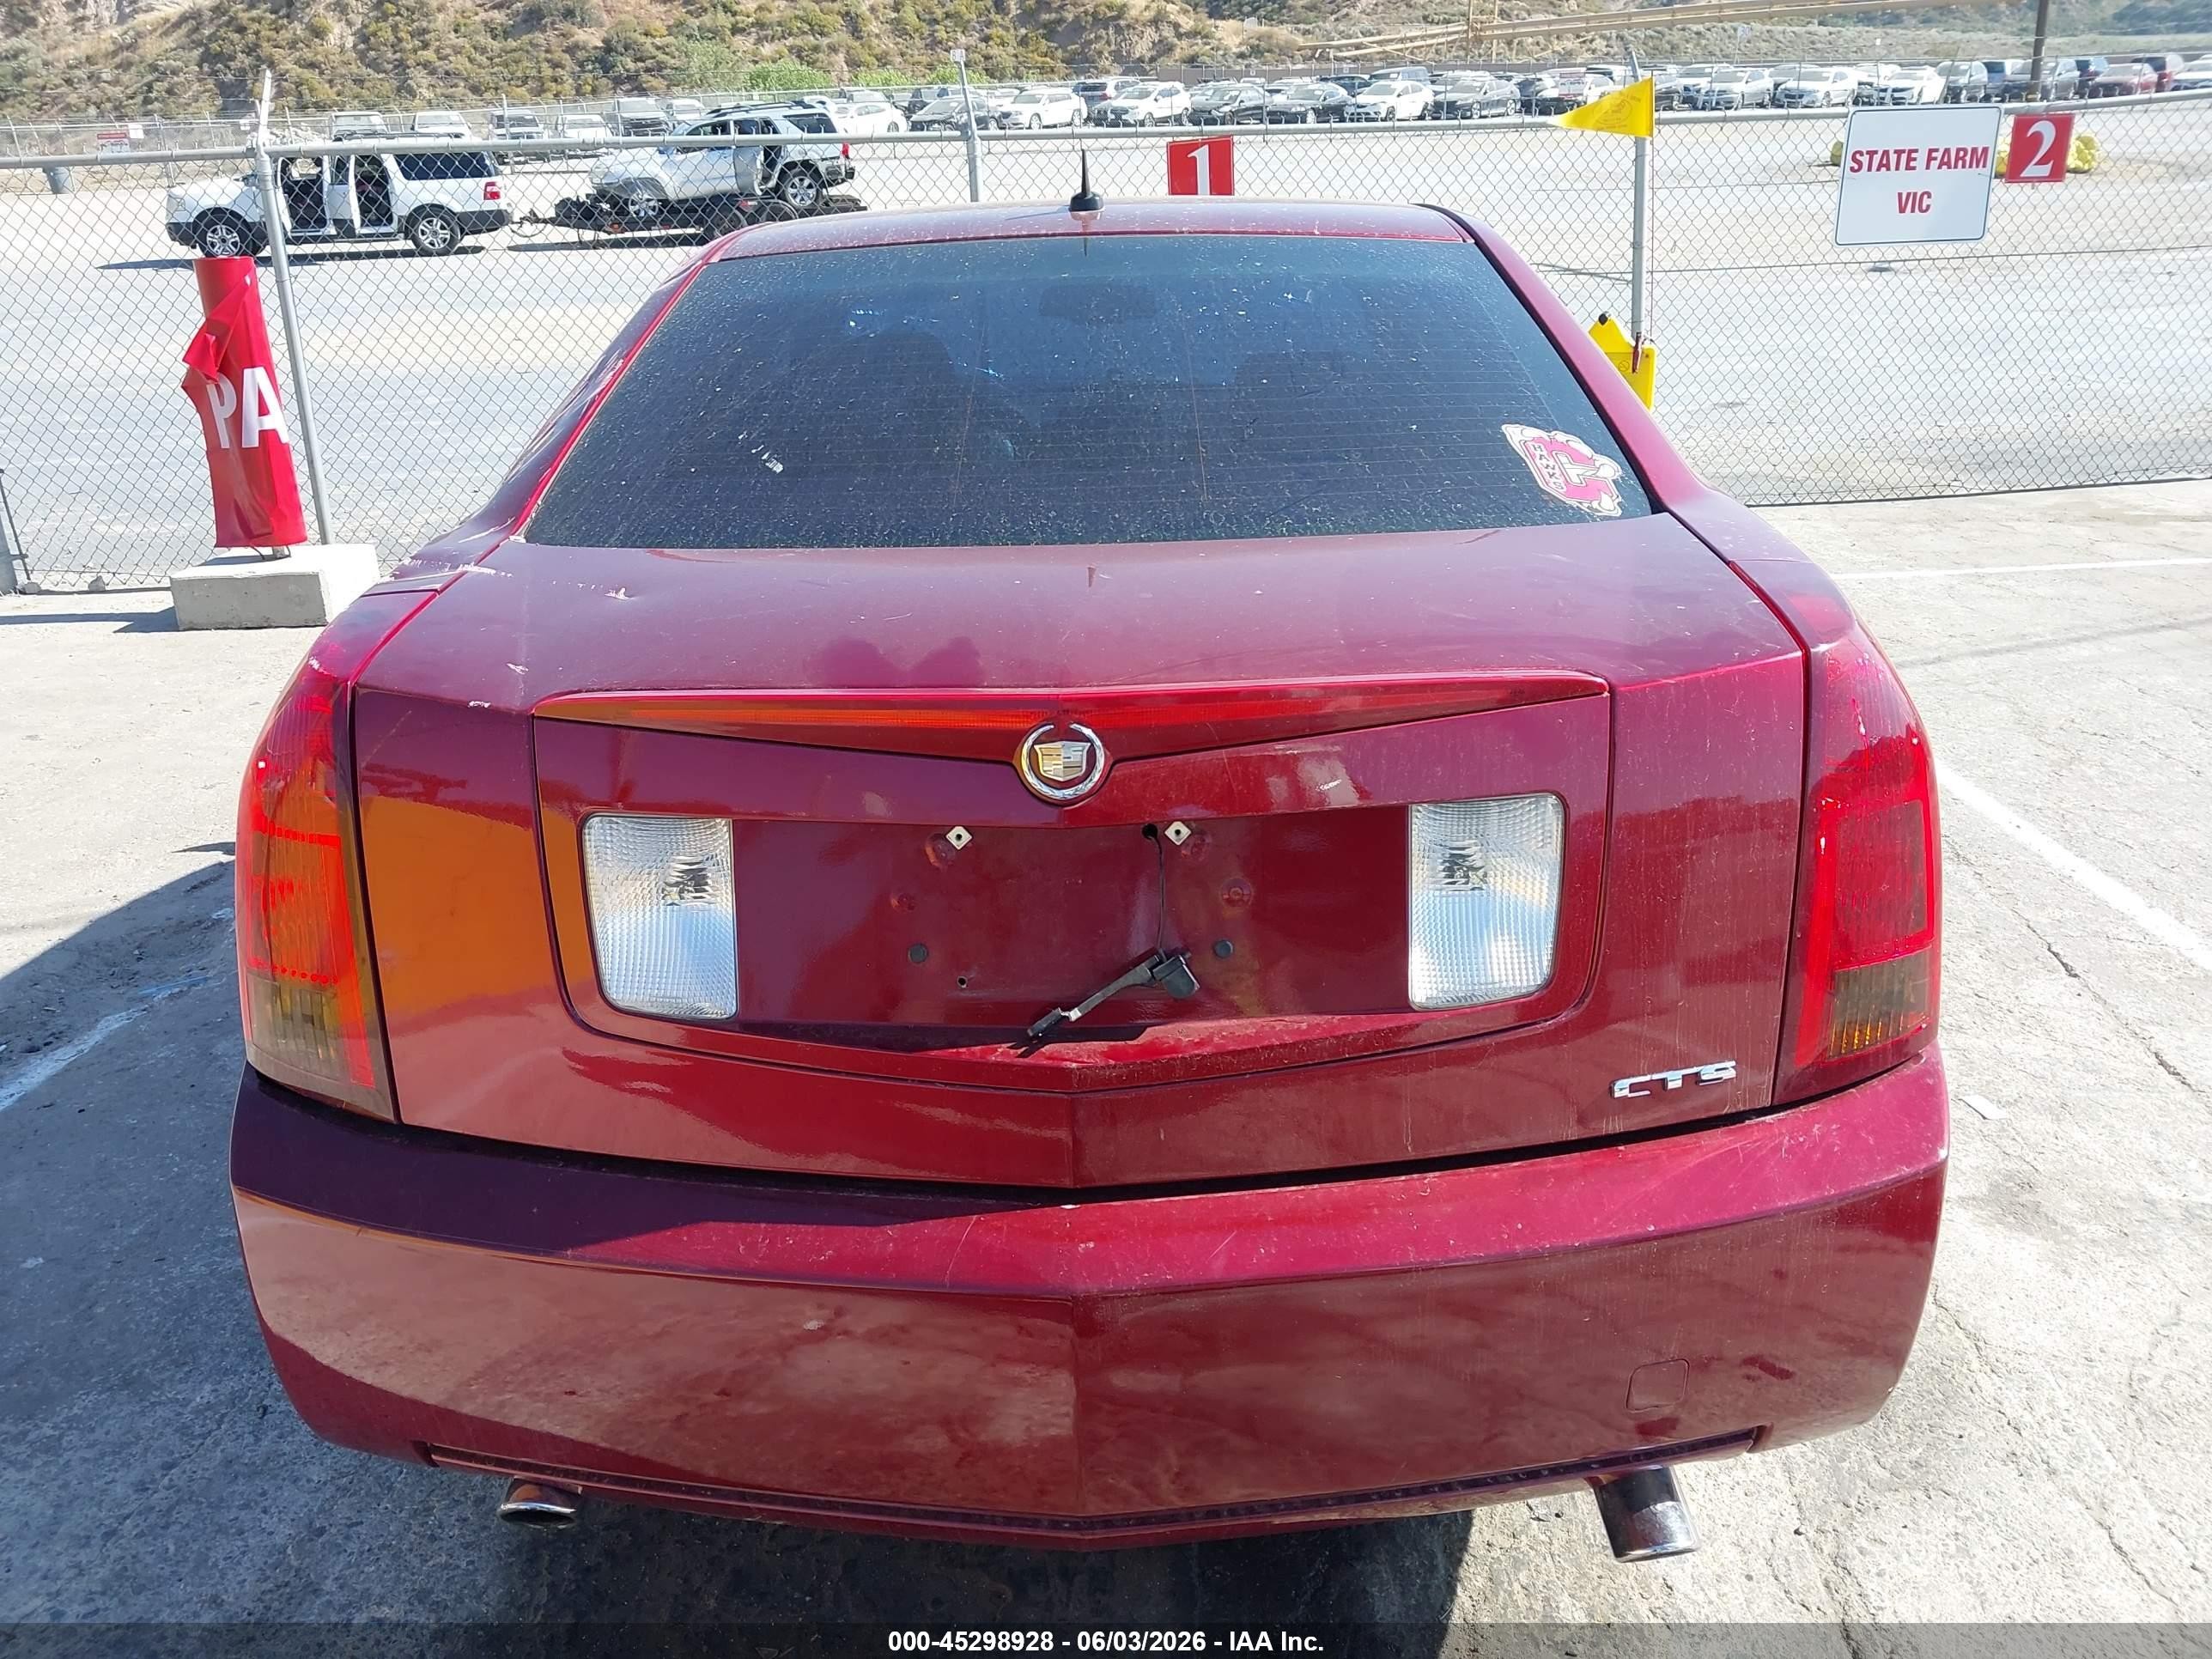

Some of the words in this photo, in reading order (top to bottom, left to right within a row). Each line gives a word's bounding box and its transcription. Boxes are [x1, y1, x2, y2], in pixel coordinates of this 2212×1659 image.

[1187, 143, 1211, 197] 1
[1849, 148, 1920, 173] STATE
[1924, 146, 1990, 171] FARM
[2020, 119, 2057, 178] 2
[1897, 190, 1933, 215] VIC
[1531, 442, 1566, 492] HAWKS
[1610, 1060, 1737, 1099] CTS
